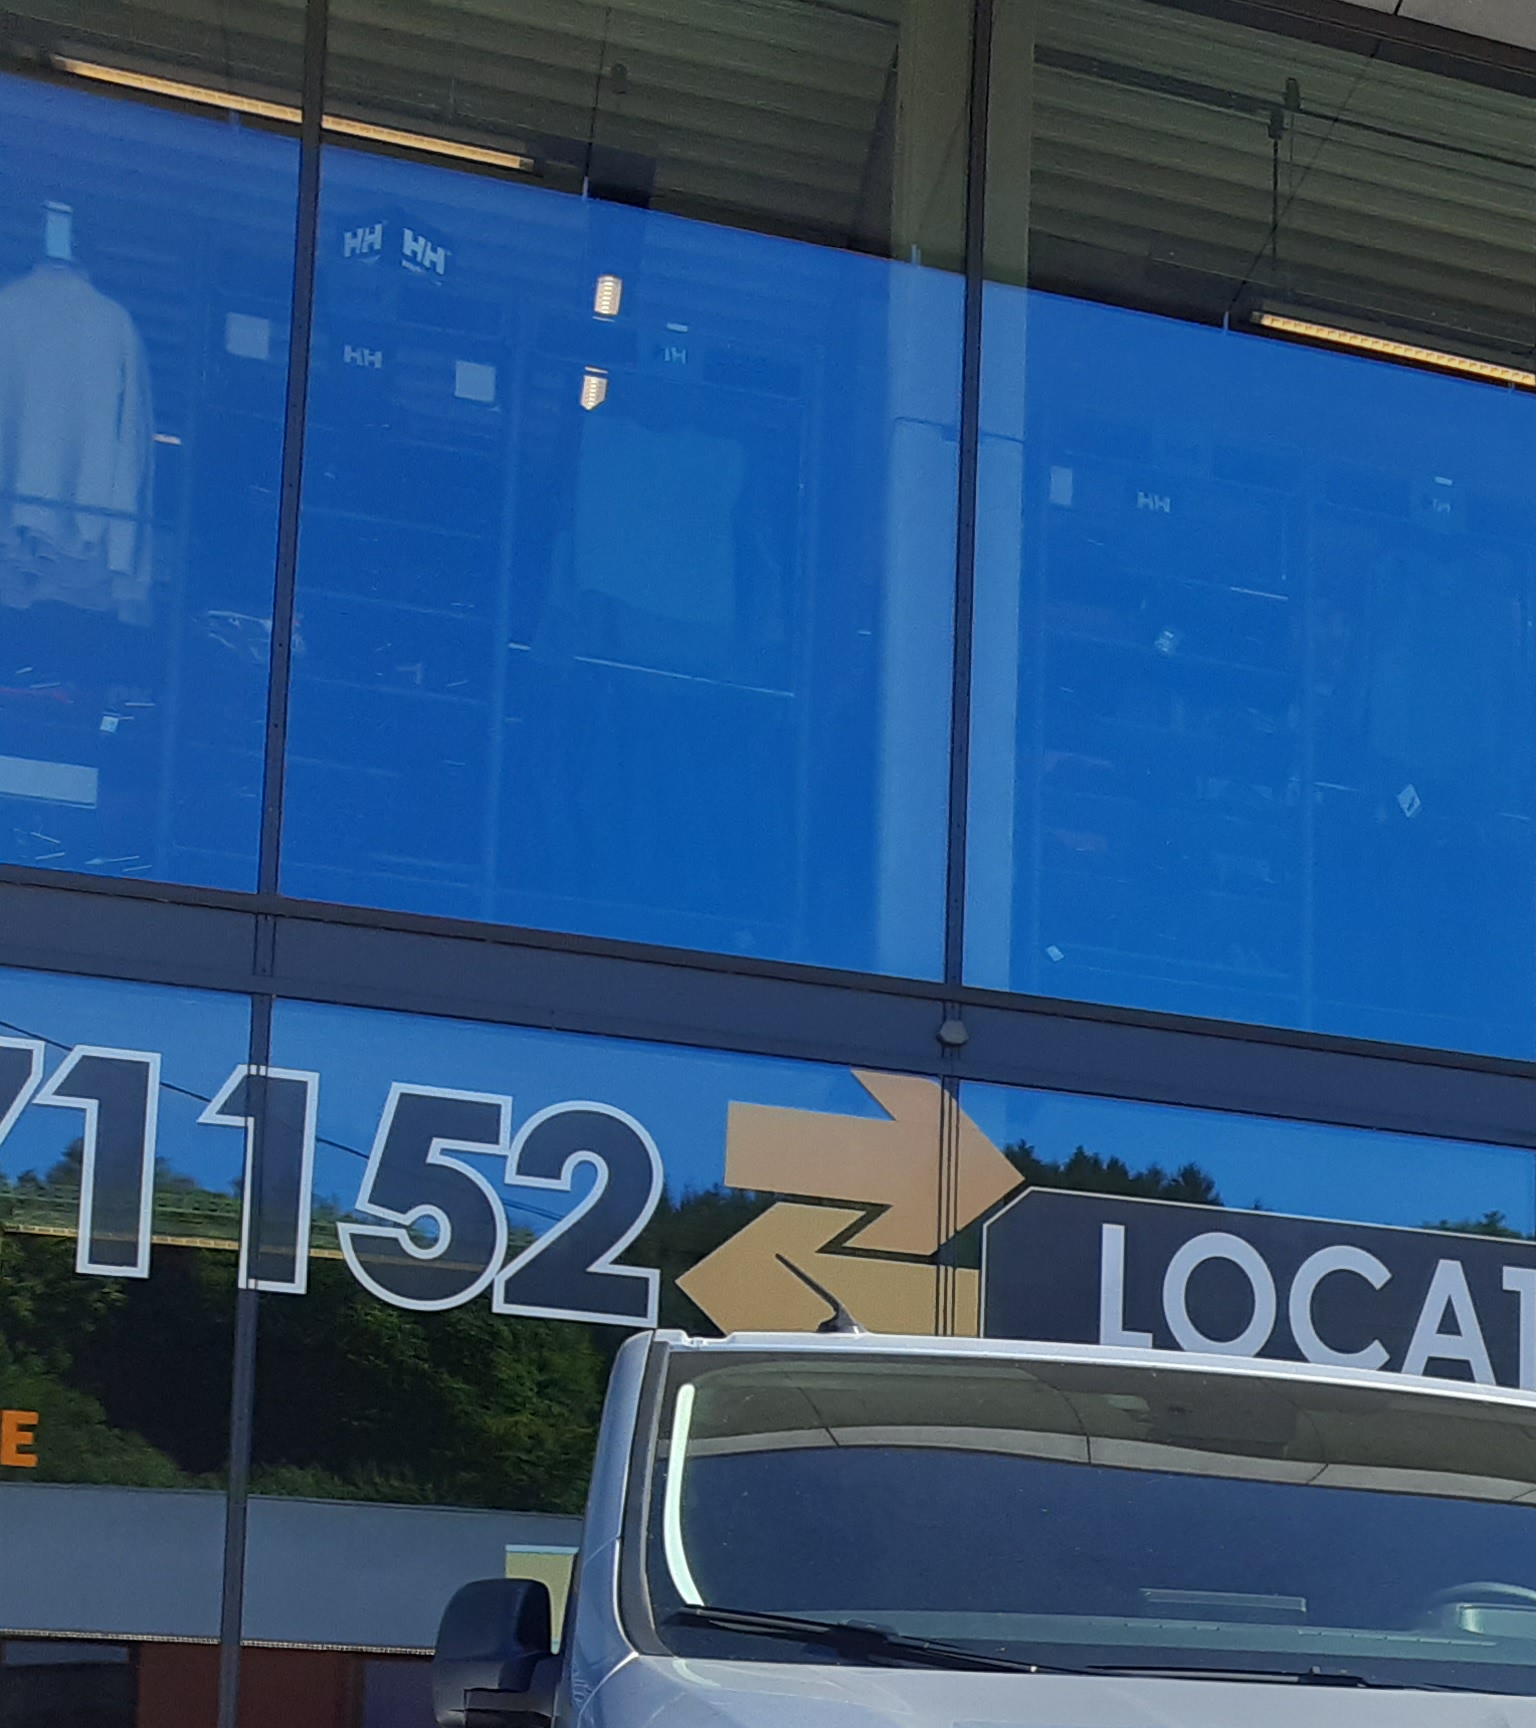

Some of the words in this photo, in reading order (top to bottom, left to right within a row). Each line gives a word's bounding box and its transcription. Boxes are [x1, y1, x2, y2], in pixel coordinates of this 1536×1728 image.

[344, 223, 384, 257] HH
[402, 228, 446, 274] HH
[344, 345, 382, 369] HH
